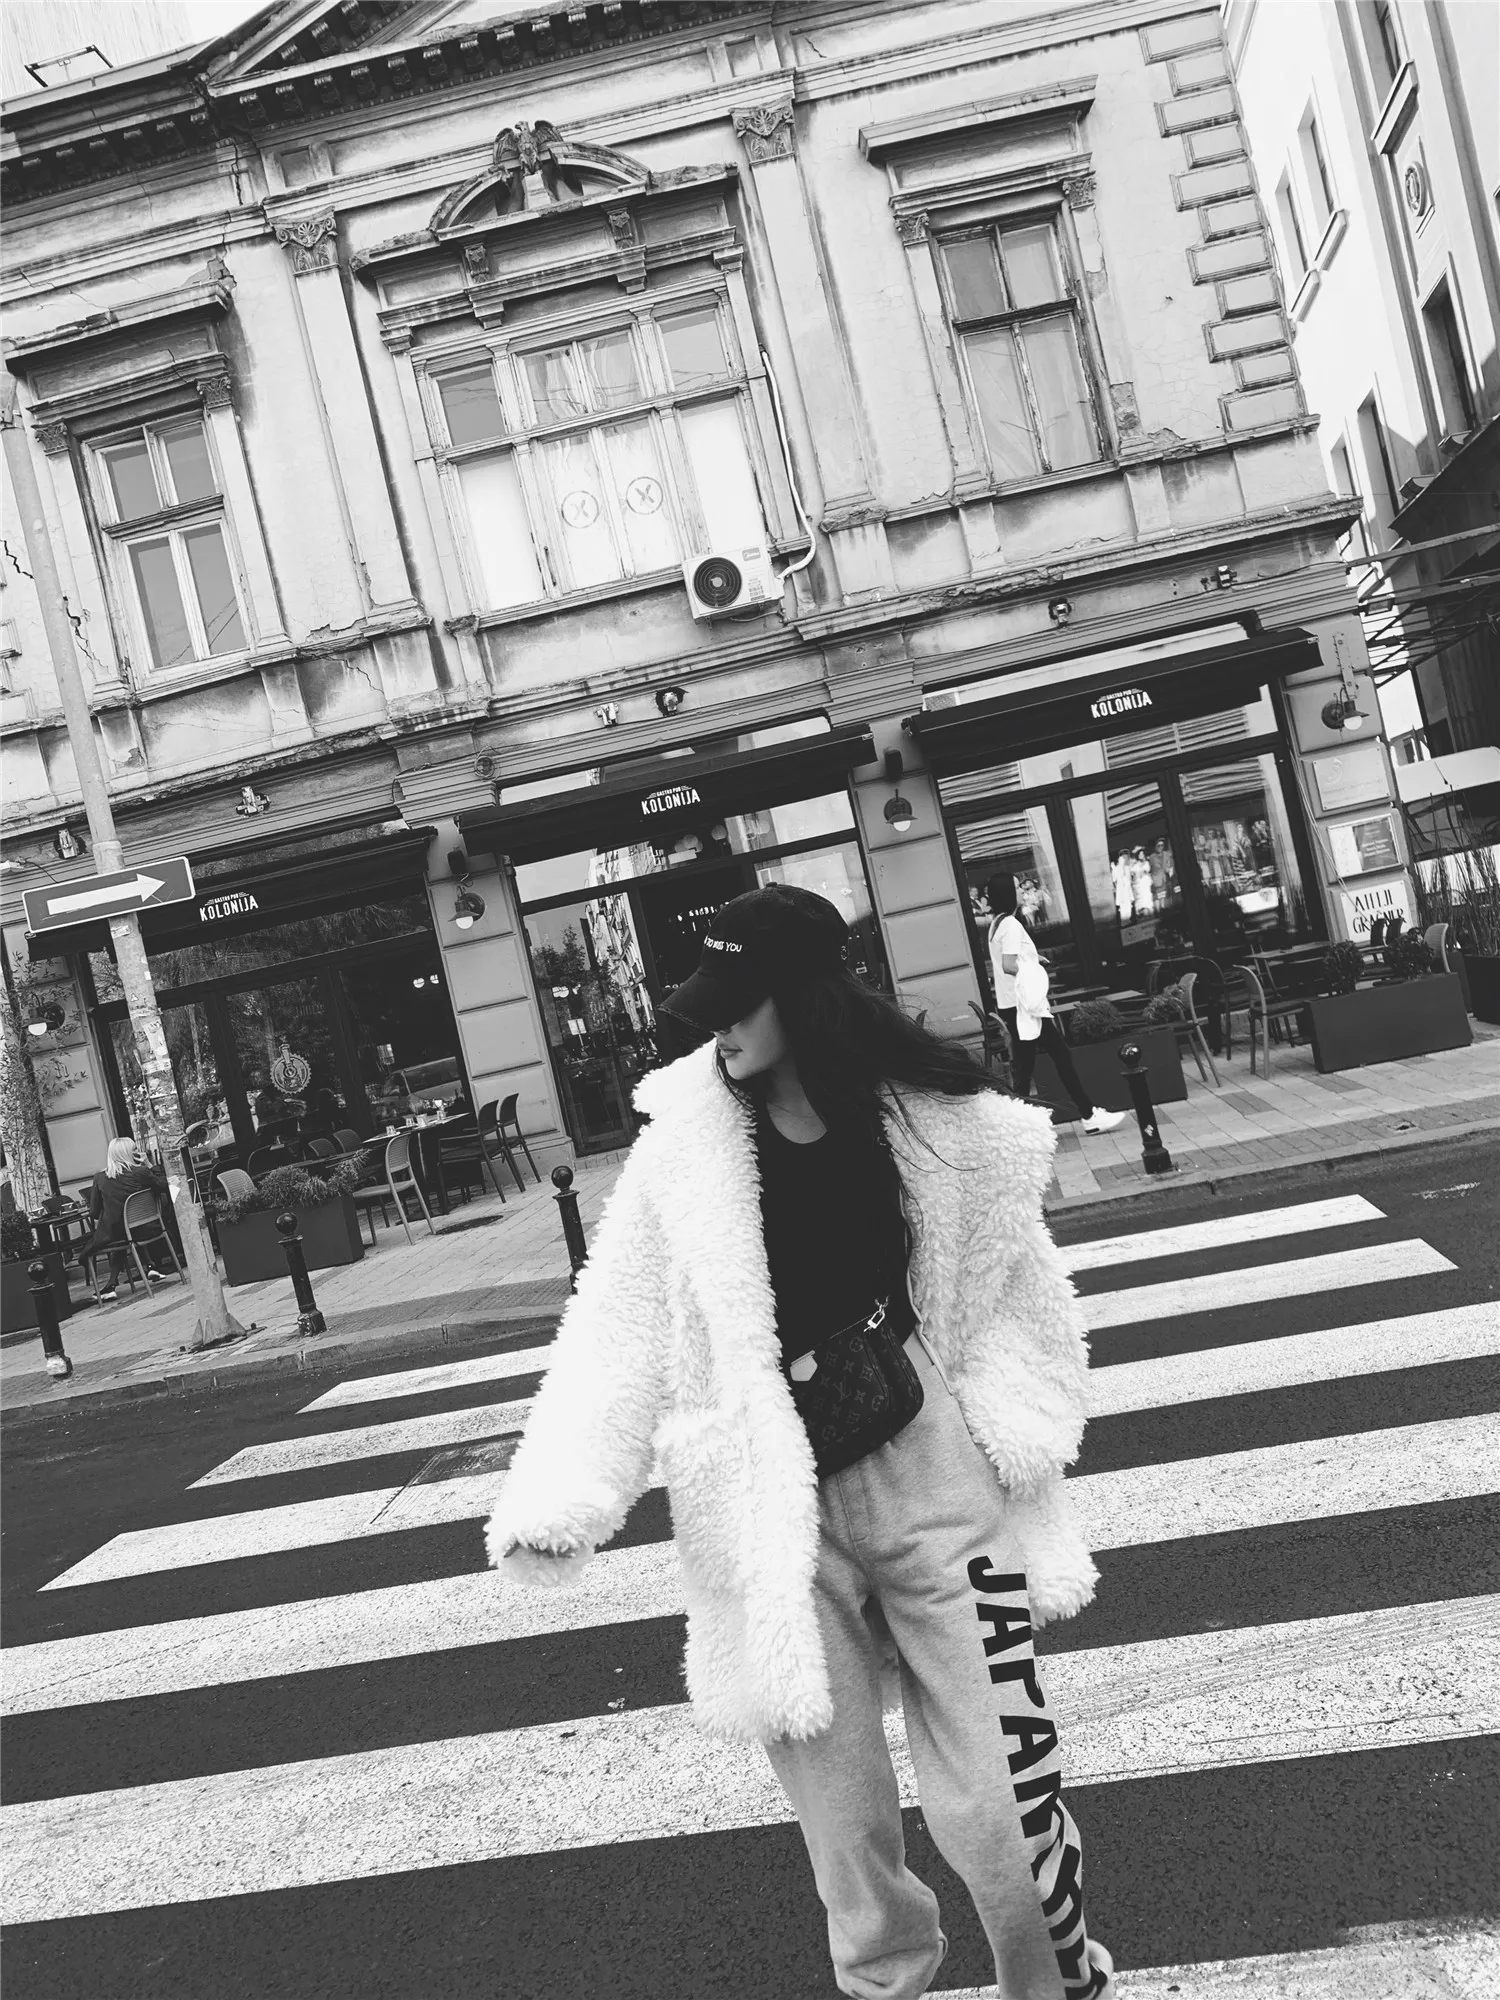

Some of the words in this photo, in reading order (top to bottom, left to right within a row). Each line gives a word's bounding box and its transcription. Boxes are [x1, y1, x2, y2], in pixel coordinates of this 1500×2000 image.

[1090, 691, 1153, 719] KOLONIJA
[641, 788, 701, 815] KOLONIJA
[199, 895, 259, 922] KOLONIJA
[725, 941, 743, 953] YOU
